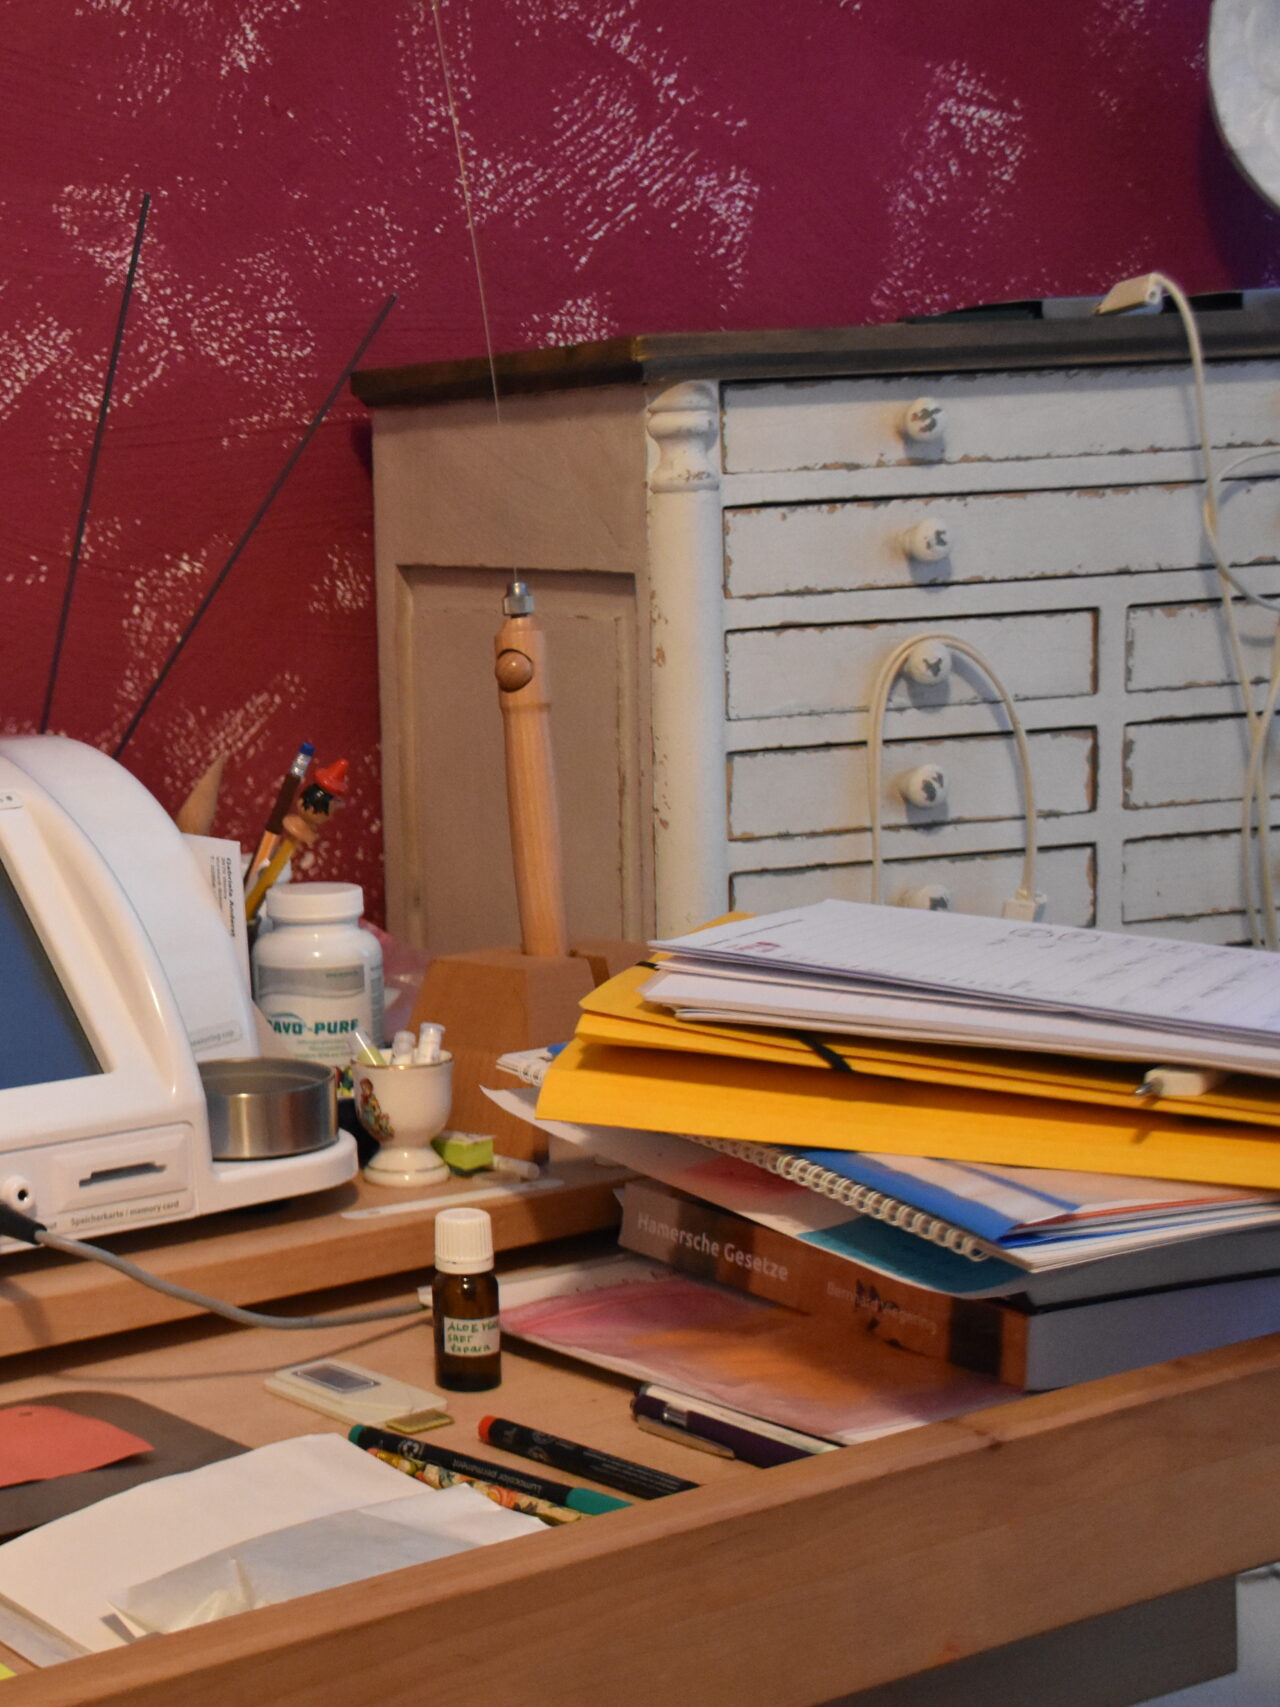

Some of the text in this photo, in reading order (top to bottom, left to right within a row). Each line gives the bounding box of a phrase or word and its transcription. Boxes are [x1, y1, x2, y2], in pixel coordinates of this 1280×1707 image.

[71, 1210, 124, 1226] Speicherkarte
[130, 1204, 161, 1217] memory
[637, 1211, 789, 1282] Hamersche Gesetze
